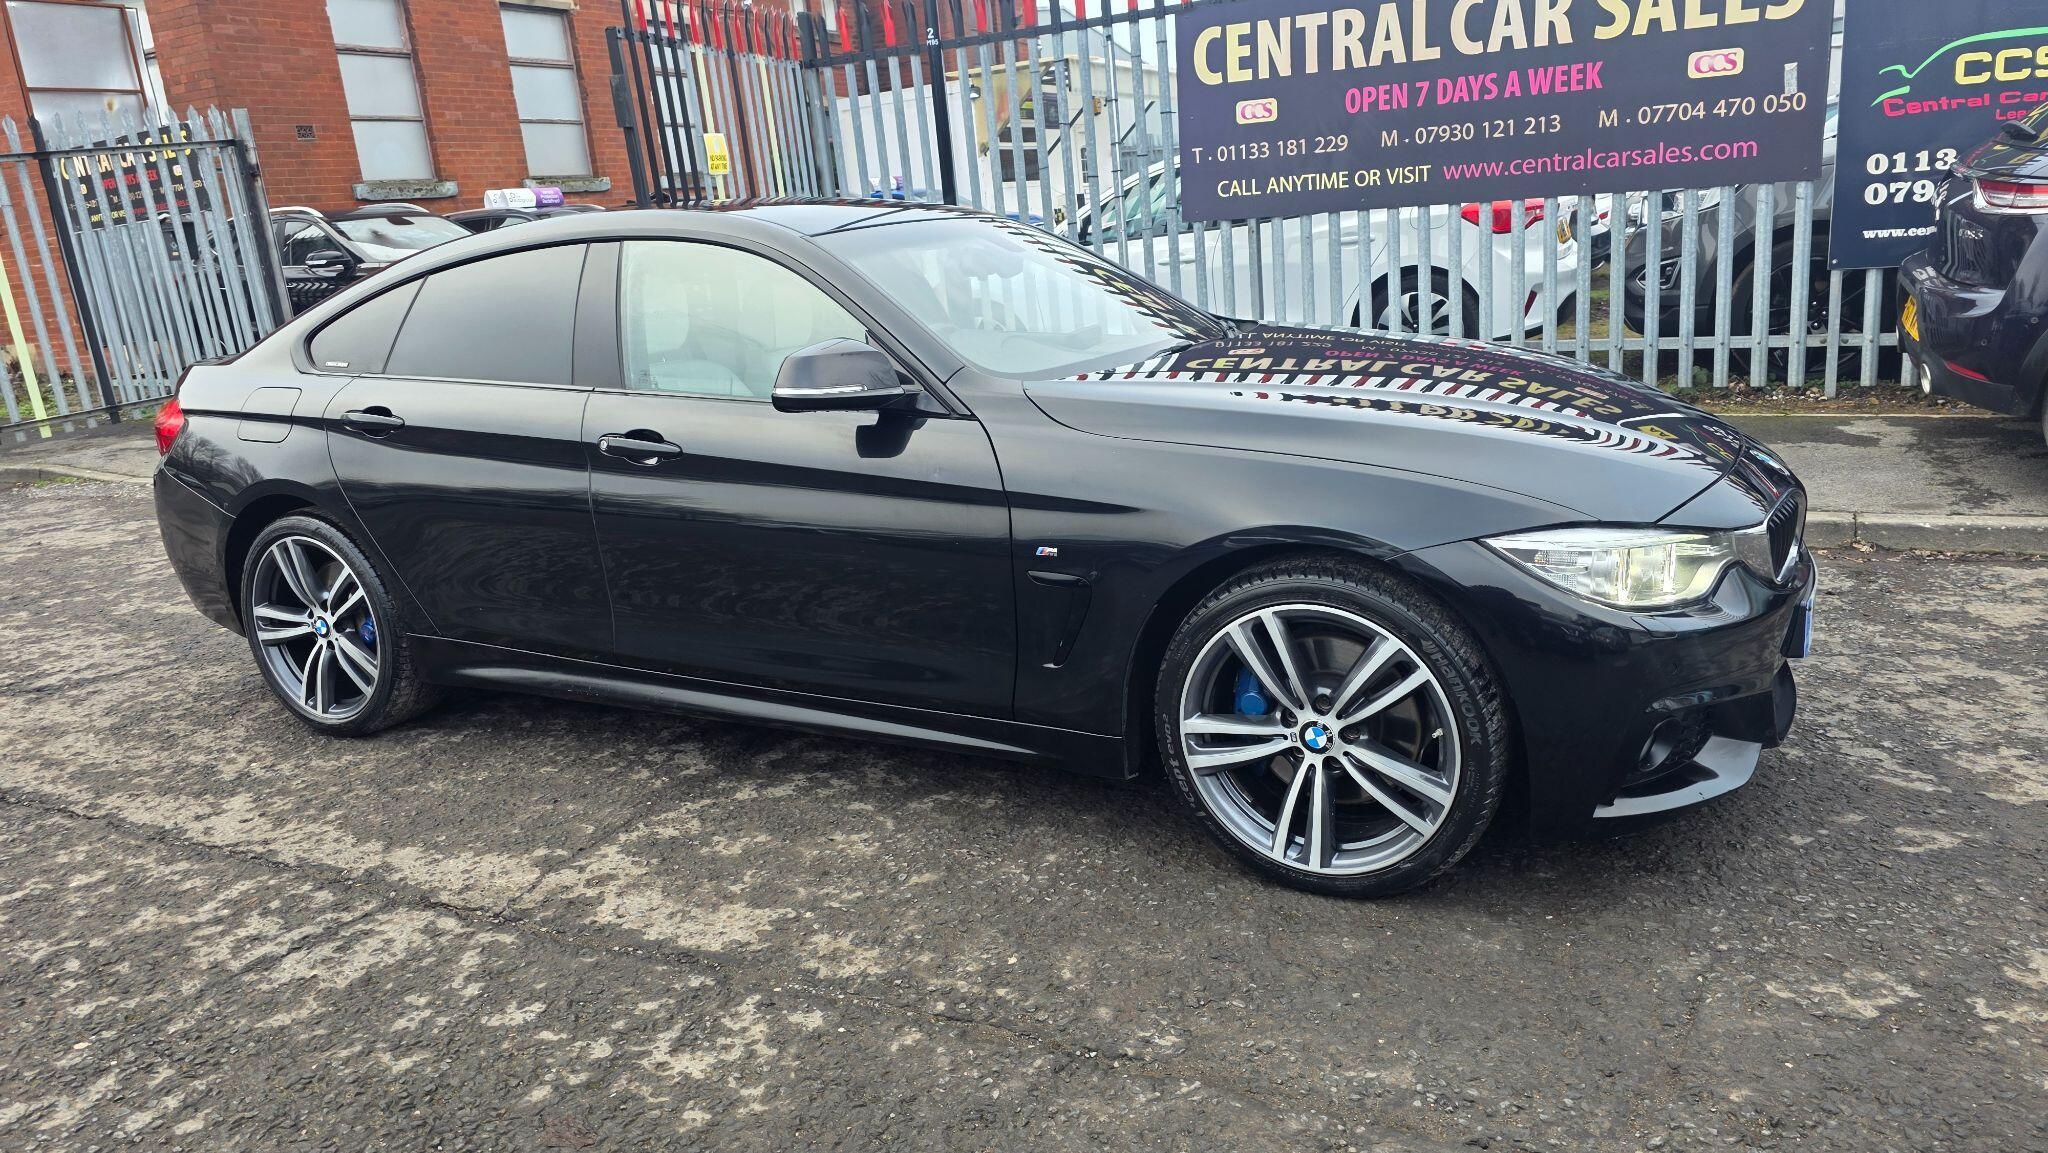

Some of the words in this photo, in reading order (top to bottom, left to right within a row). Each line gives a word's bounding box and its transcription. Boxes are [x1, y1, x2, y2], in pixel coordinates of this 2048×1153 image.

[926, 27, 935, 39] 2
[1193, 0, 1441, 85] CENTRAL
[1450, 0, 1573, 55] CAR
[1594, 0, 1804, 39] SAL
[1693, 52, 1738, 74] CCS
[1345, 82, 1408, 114] OPEN
[1415, 80, 1430, 107] 7
[1436, 72, 1499, 105] DAYS
[1504, 70, 1521, 98] A
[1528, 61, 1604, 96] WEEK
[1240, 102, 1274, 121] CCS
[1598, 108, 1618, 128] M
[1637, 101, 1706, 125] 07704
[1712, 96, 1756, 117] 470
[1763, 92, 1807, 113] 050
[1883, 93, 1990, 117] Central
[1381, 129, 1398, 147] M
[1415, 122, 1475, 145] 07930
[1482, 119, 1515, 138] 121
[1524, 114, 1561, 135] 213
[1217, 142, 1270, 162] 01133
[1277, 138, 1306, 156] 181
[1314, 134, 1349, 153] 229
[1217, 179, 1262, 198] CALL
[1267, 171, 1349, 194] ANYTIME
[1354, 169, 1381, 187] OR
[1386, 164, 1432, 185] VISIT
[1443, 140, 1758, 180] www.centralcarsales.com
[1866, 149, 1957, 176] 0113
[1864, 180, 1935, 206] 079
